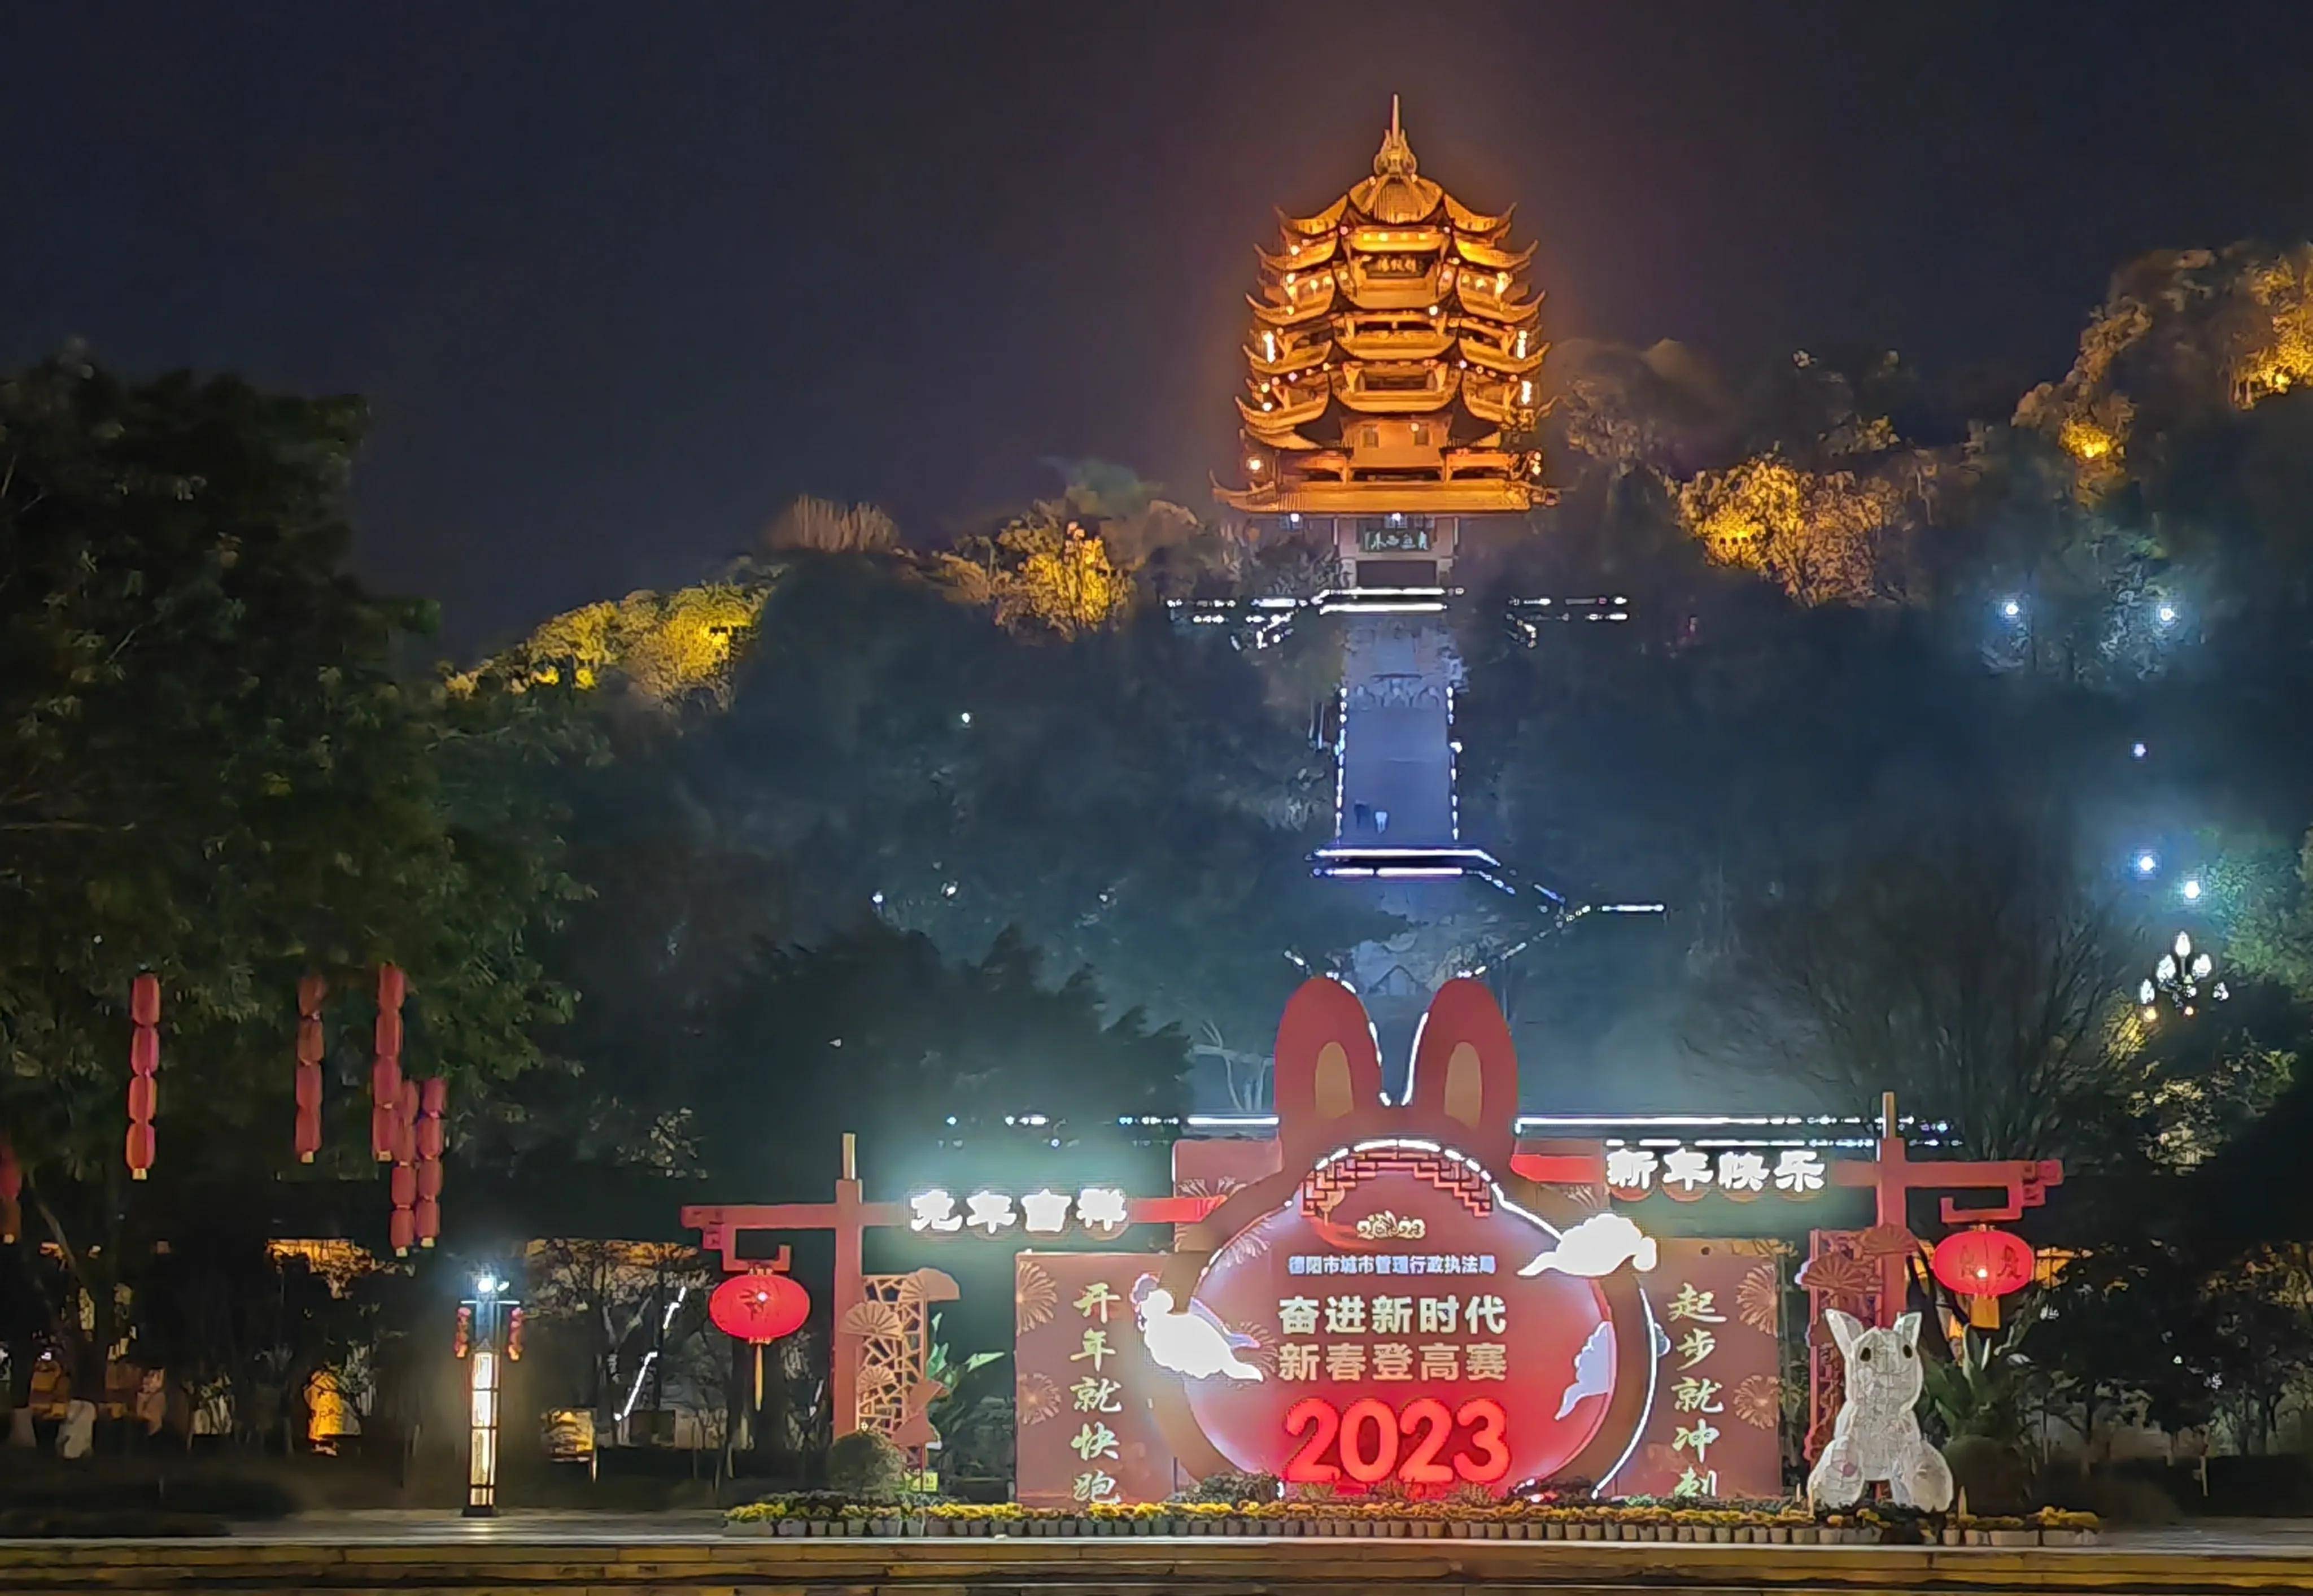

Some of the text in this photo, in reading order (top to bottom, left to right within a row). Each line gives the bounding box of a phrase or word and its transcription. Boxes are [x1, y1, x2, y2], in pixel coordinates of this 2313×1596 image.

[1606, 1148, 1825, 1192] 新年快乐
[1288, 1255, 1496, 1275] 德阳市城市管理行政执法局
[1278, 1294, 1507, 1335] 奋进新时代
[1278, 1342, 1507, 1381] 新春登高赛
[1070, 1282, 1122, 1504] 开年就快跑
[1667, 1282, 1727, 1497] 起步就冲刺
[1283, 1397, 1512, 1484] 2023
